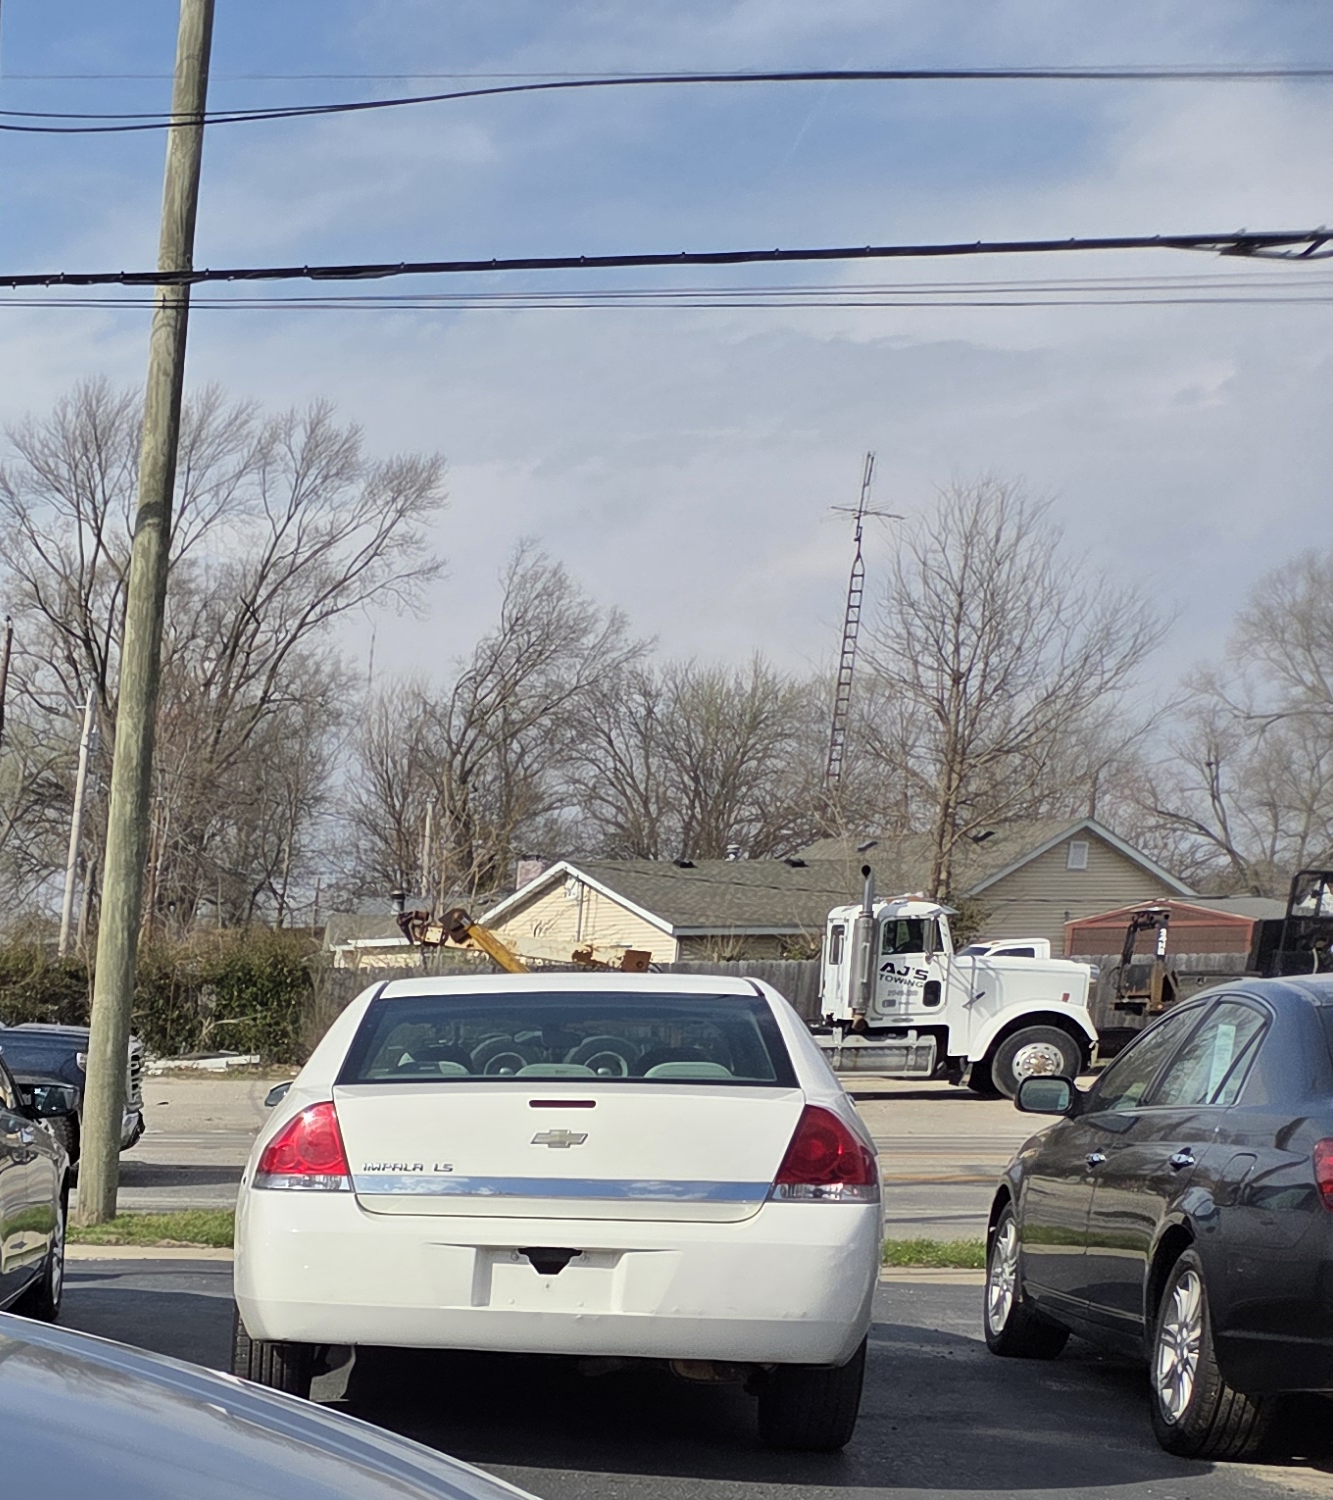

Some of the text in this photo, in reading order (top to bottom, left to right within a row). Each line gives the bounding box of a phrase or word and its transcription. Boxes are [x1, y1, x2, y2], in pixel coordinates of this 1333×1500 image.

[879, 962, 929, 981] AJ'S
[879, 973, 924, 988] TOWING
[363, 1162, 454, 1173] IMPALA LS
